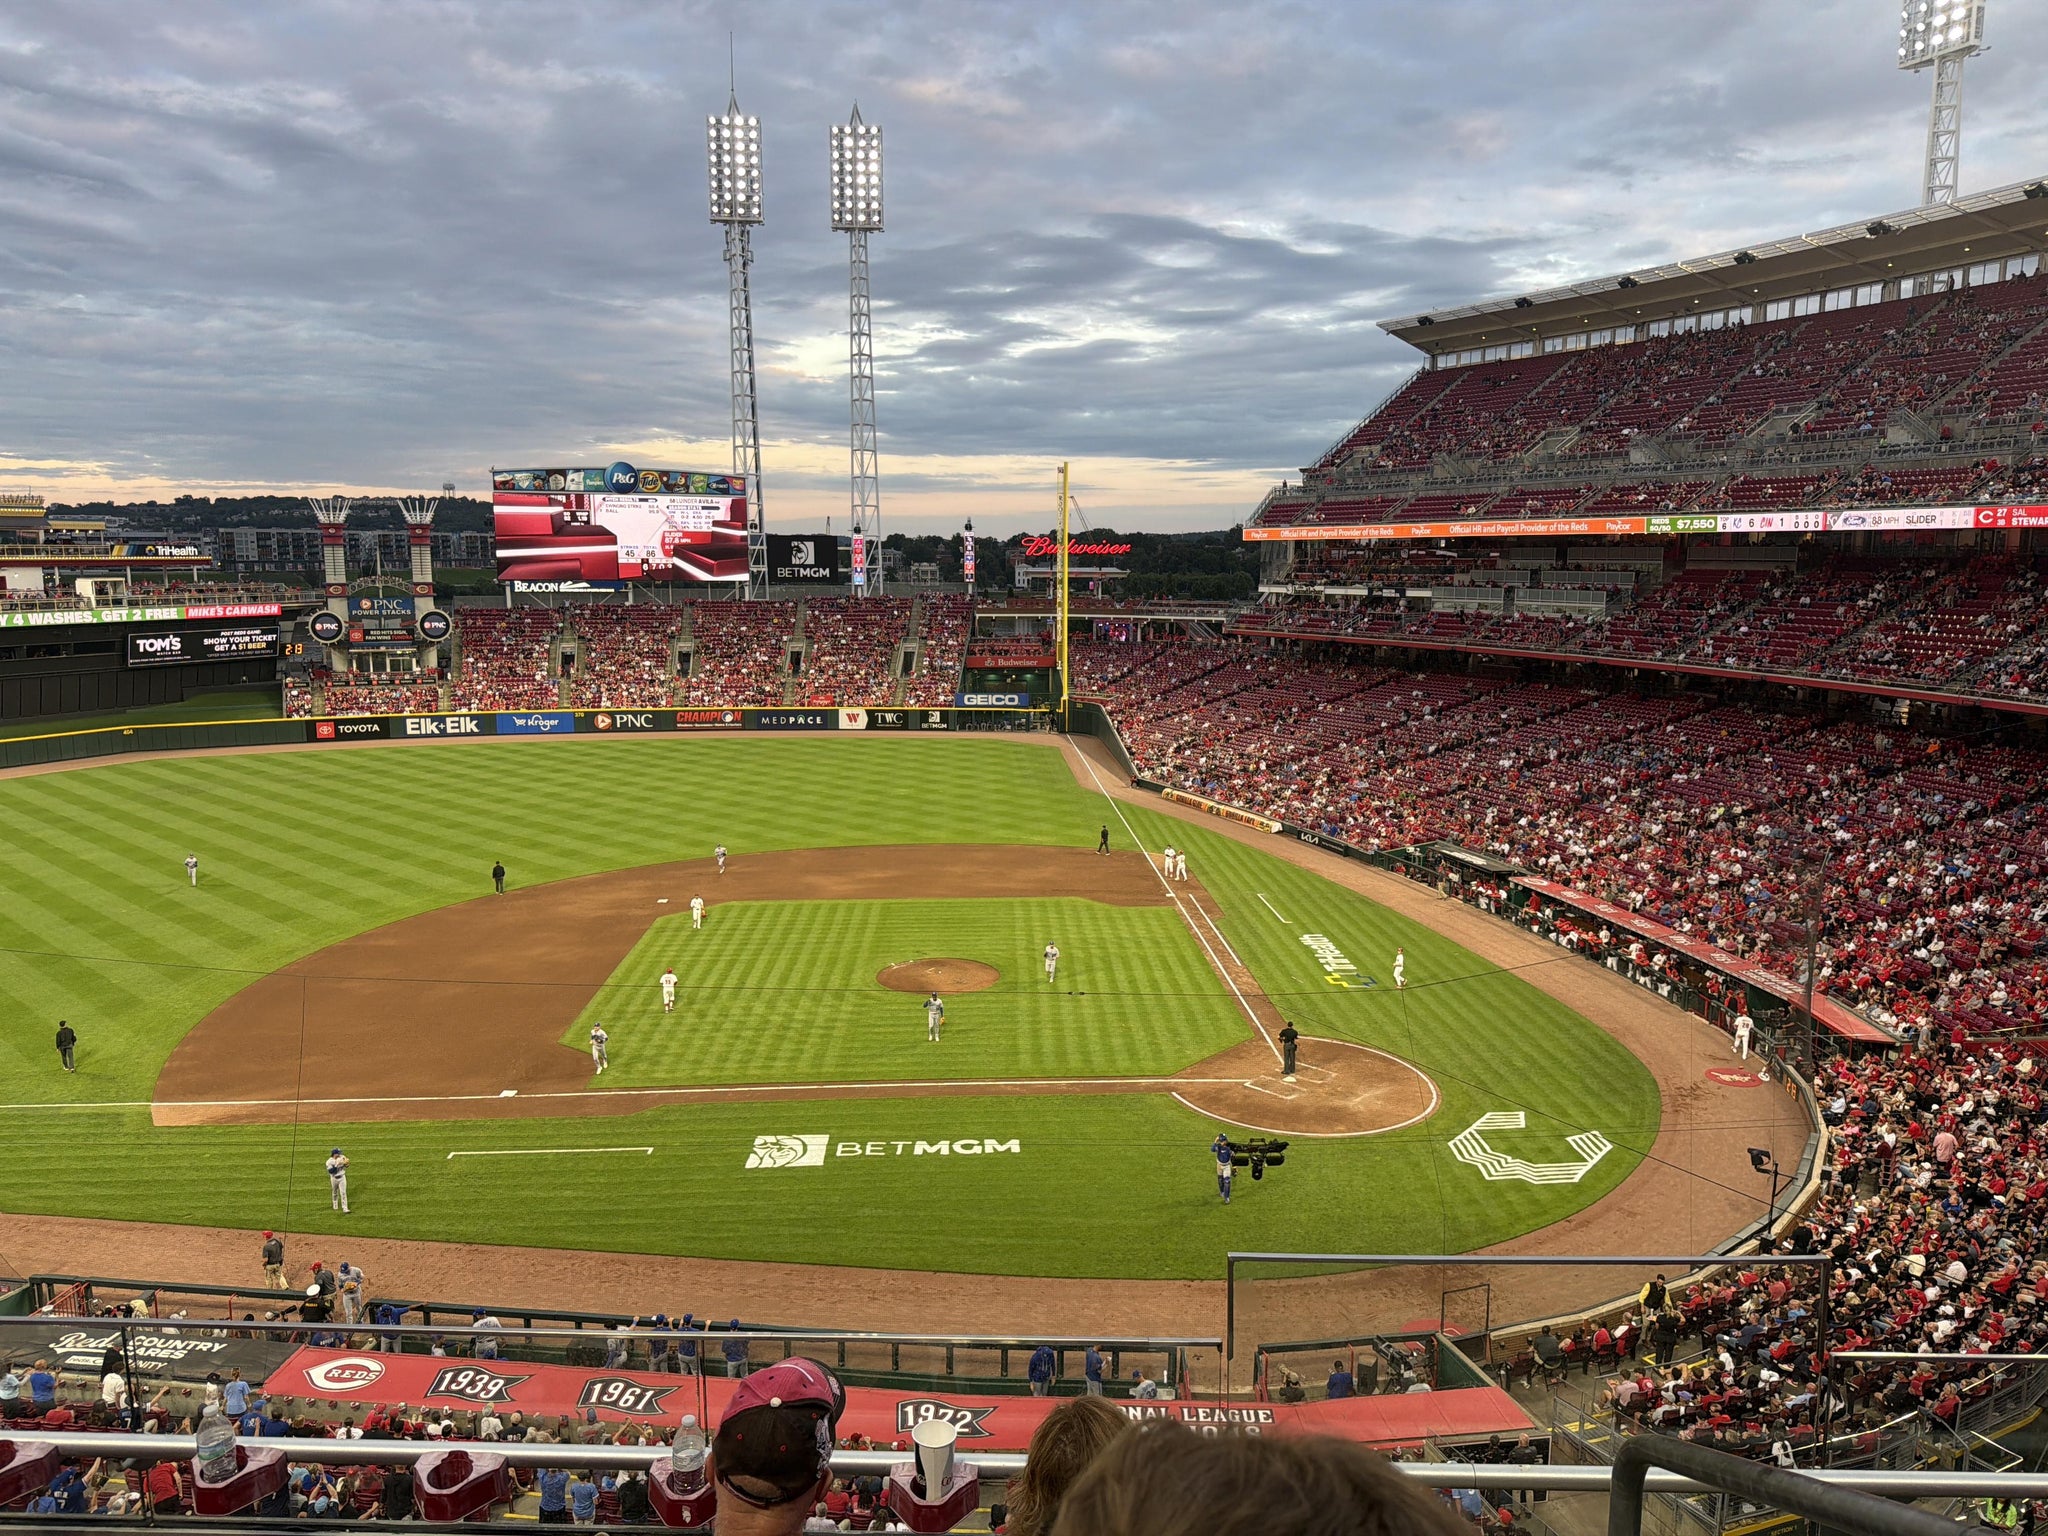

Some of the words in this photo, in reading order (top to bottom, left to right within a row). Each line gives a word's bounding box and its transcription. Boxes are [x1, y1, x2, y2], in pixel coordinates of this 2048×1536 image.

[612, 472, 635, 484] P&G
[640, 475, 658, 488] Tide
[1676, 518, 1715, 529] $7,550
[1732, 518, 1742, 528] KC
[1749, 519, 1755, 528] 6
[1760, 518, 1773, 528] CIN
[1780, 518, 1784, 527] 1
[1905, 515, 1936, 524] SLIDER
[1319, 529, 1337, 538] Payroll
[1338, 528, 1362, 536] Provider
[1411, 526, 1431, 537] Paycor
[1449, 525, 1471, 534] Official
[1483, 525, 1495, 533] and
[1497, 524, 1519, 535] Payroll
[1520, 523, 1548, 532] Provider
[1550, 523, 1556, 531] of
[1558, 523, 1569, 531] the
[1571, 522, 1587, 531] Reds
[1606, 520, 1631, 532] Paycor
[156, 546, 198, 556] TriHealth
[777, 568, 830, 578] BETMGM
[514, 580, 558, 592] BEACON
[188, 606, 223, 617] MIKE'S
[226, 604, 278, 616] CARWASH
[373, 600, 403, 610] PNC
[13, 614, 24, 625] 4
[28, 611, 97, 625] WASHES,
[101, 610, 128, 622] GET
[133, 610, 142, 621] 2
[145, 608, 178, 619] FREE
[136, 634, 181, 652] TOM'S
[203, 637, 228, 645] SHOW
[964, 694, 1019, 705] GEICO
[614, 714, 653, 728] PNC
[676, 711, 742, 722] CHAMPION
[762, 715, 823, 725] MEDPACE
[846, 713, 860, 723] W
[875, 713, 903, 723] TWC
[338, 724, 380, 734] TOYOTA
[406, 716, 480, 735] Elk+Elk
[528, 715, 559, 731] Kroger
[836, 1139, 1021, 1157] BETMGM
[48, 1332, 122, 1348] Red
[129, 1336, 228, 1352] COUNTRY
[326, 1369, 380, 1380] REDS
[440, 1371, 504, 1399] 1939
[590, 1382, 651, 1410] 1961
[904, 1404, 972, 1432] 1972
[1182, 1407, 1272, 1423] LEAGUE
